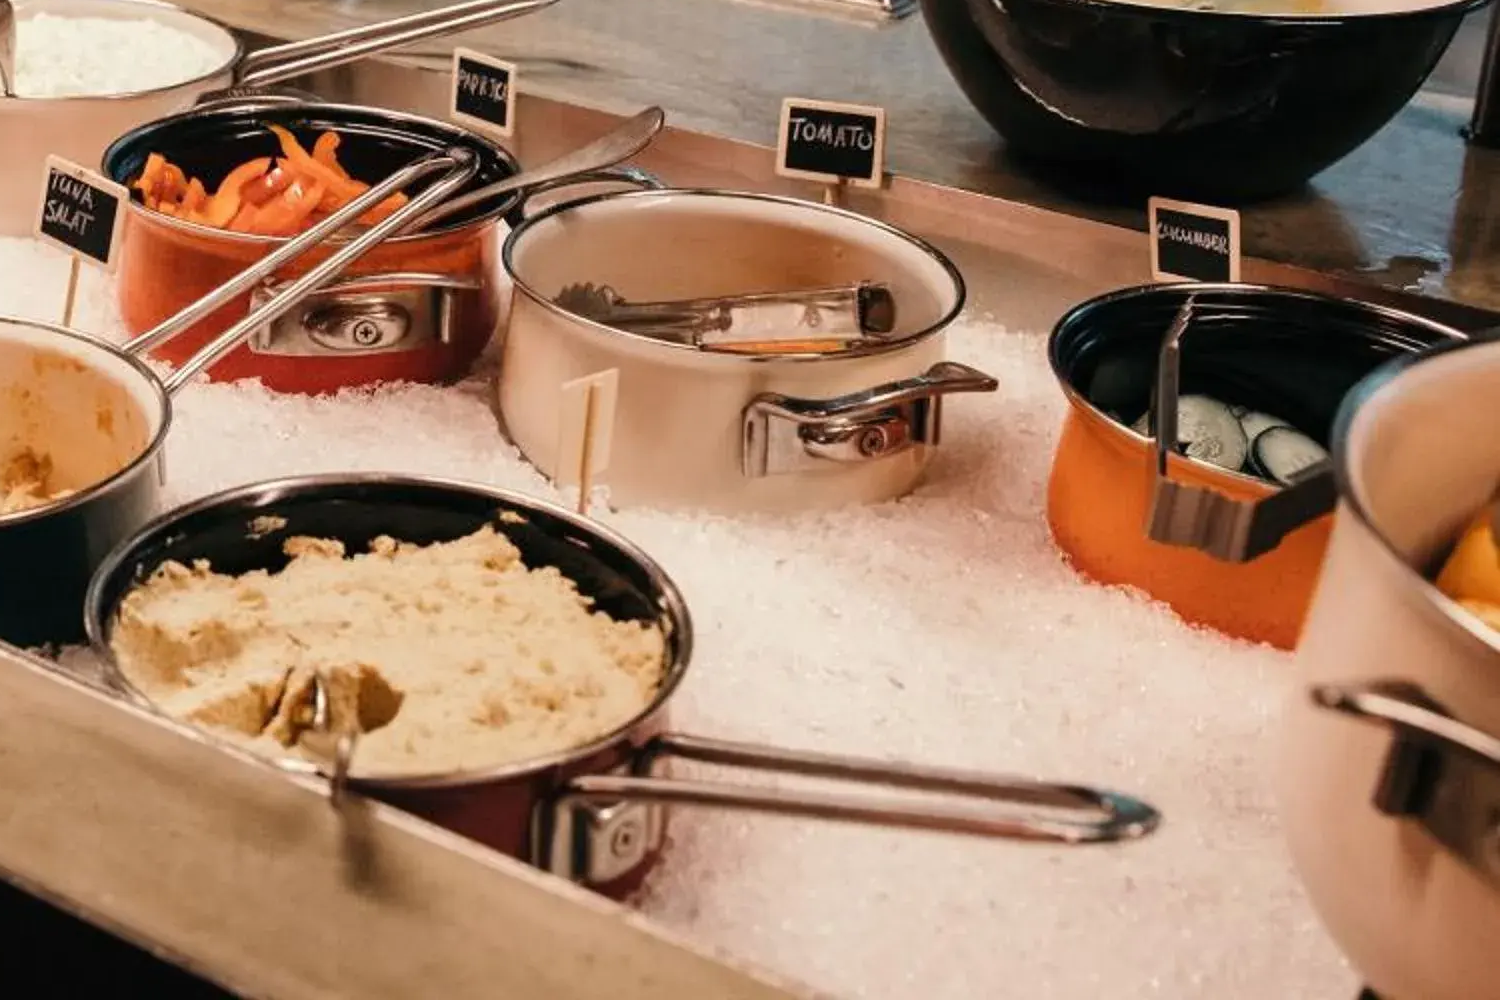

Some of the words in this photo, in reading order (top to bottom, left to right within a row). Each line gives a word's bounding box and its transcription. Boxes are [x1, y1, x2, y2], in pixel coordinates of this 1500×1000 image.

[789, 117, 873, 151] TOMATO
[51, 169, 93, 211] TUNA
[45, 199, 96, 236] SALAT
[1157, 221, 1230, 255] CUCUMBER
